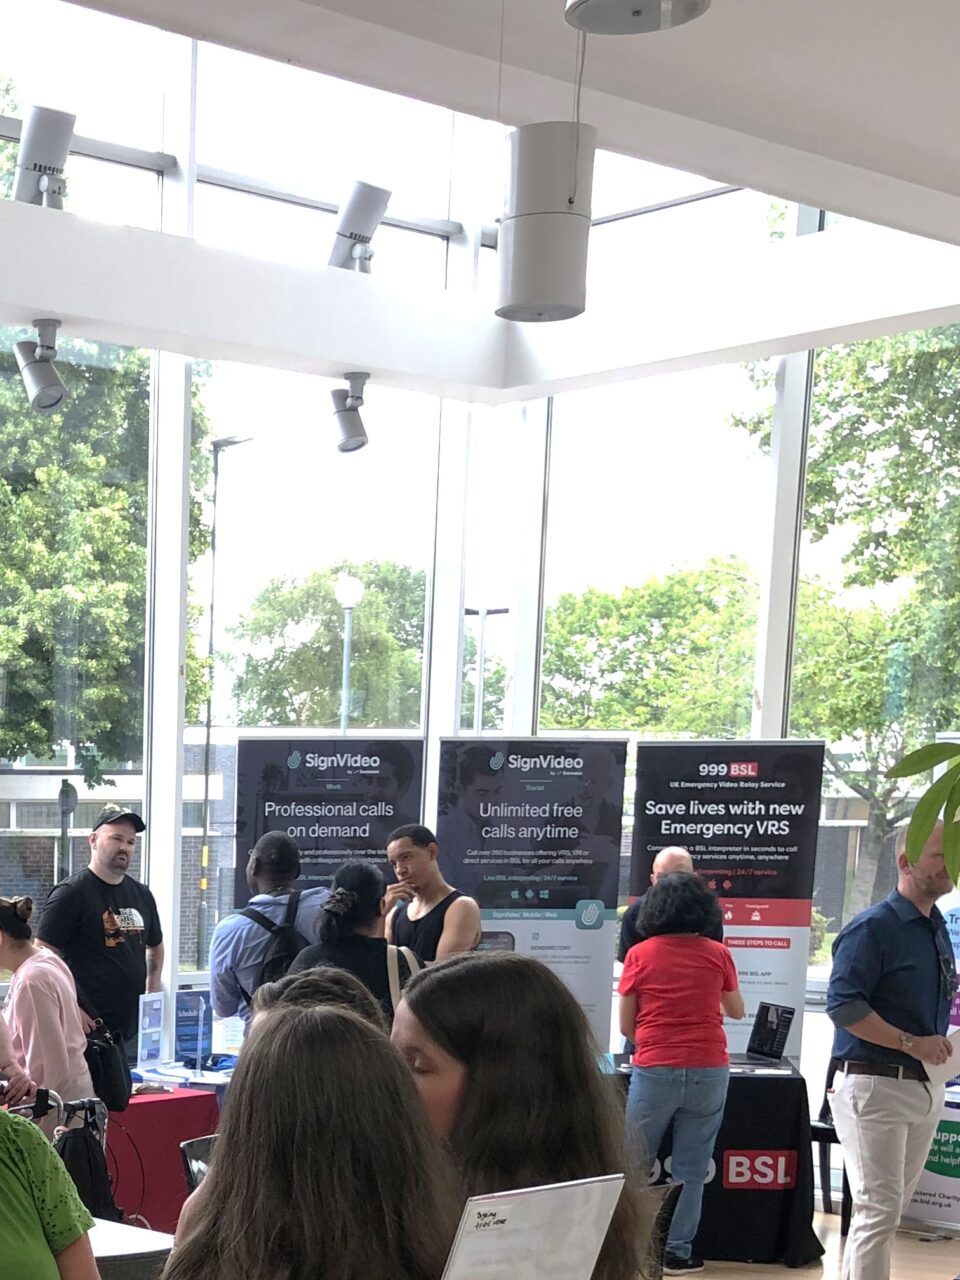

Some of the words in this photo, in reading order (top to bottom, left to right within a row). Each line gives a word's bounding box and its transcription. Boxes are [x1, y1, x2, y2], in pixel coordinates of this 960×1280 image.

[305, 753, 380, 771] SignVideo
[508, 754, 583, 771] SignVideo
[699, 764, 727, 776] 999
[730, 763, 756, 776] BSL
[265, 802, 357, 817] Professional
[358, 802, 394, 817] calls
[479, 802, 550, 818] Unlimited
[552, 802, 584, 818] free
[645, 800, 686, 815] Save
[690, 800, 726, 815] lives
[729, 800, 765, 815] with
[769, 804, 805, 815] new
[286, 826, 306, 838] on
[308, 823, 370, 837] demand
[481, 823, 516, 838] calls
[518, 823, 579, 841] anytime
[661, 820, 754, 838] Emergency
[756, 820, 790, 835] VRS
[728, 1155, 791, 1184] BSL
